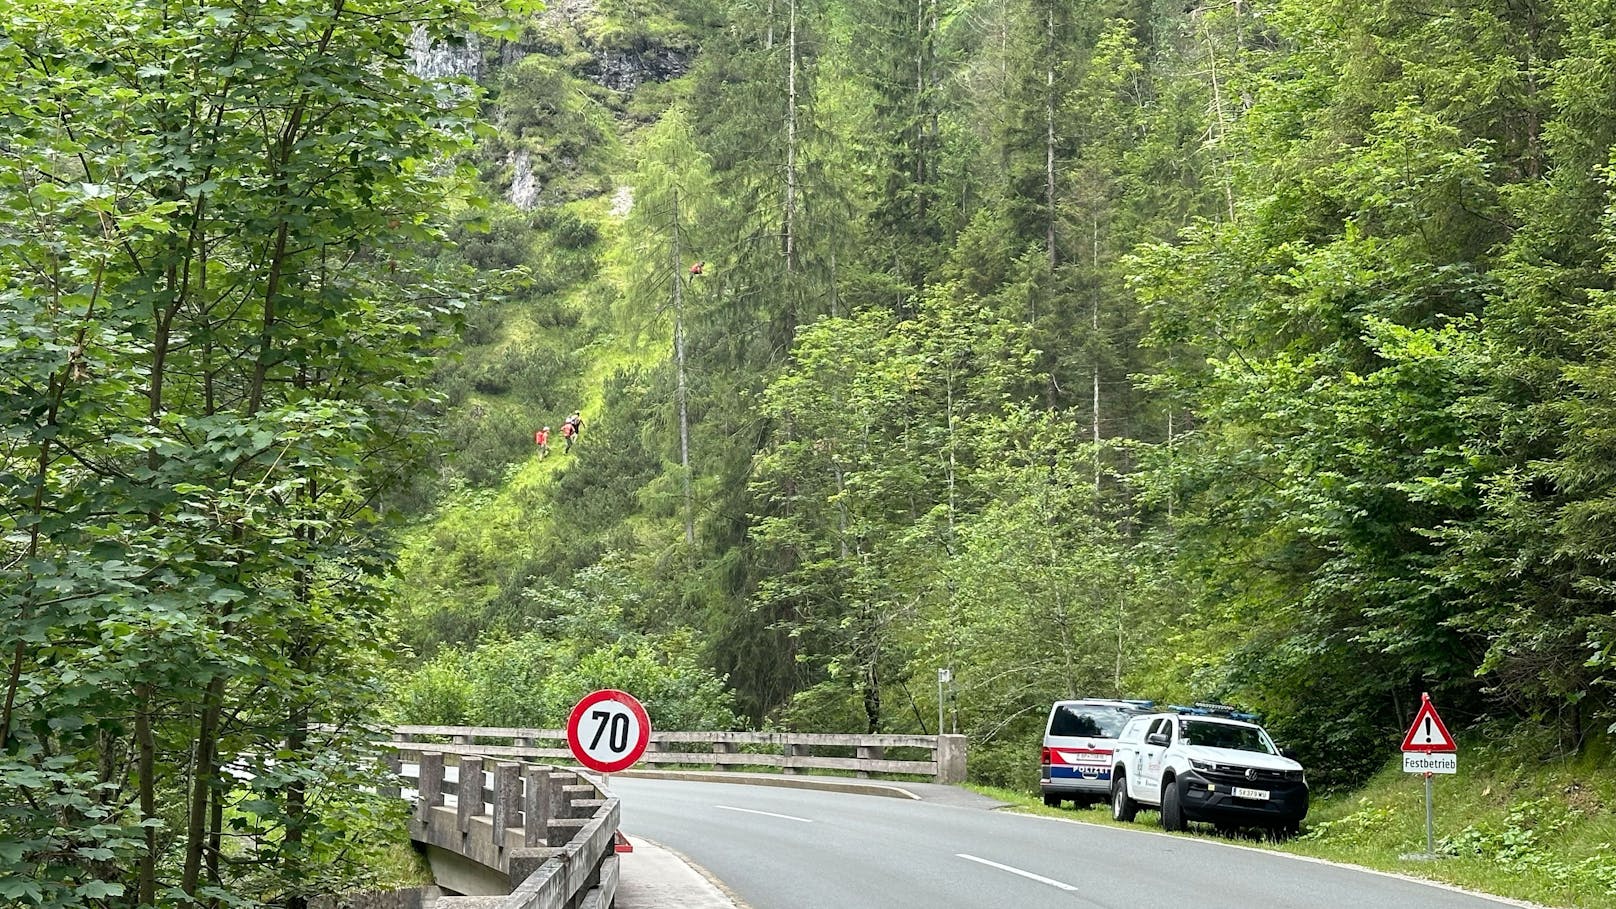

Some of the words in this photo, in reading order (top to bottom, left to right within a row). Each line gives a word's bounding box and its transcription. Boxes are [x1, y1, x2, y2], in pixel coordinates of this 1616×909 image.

[589, 710, 630, 753] 70
[1405, 757, 1456, 769] Festbetrieb
[1072, 766, 1108, 774] POLIZEI
